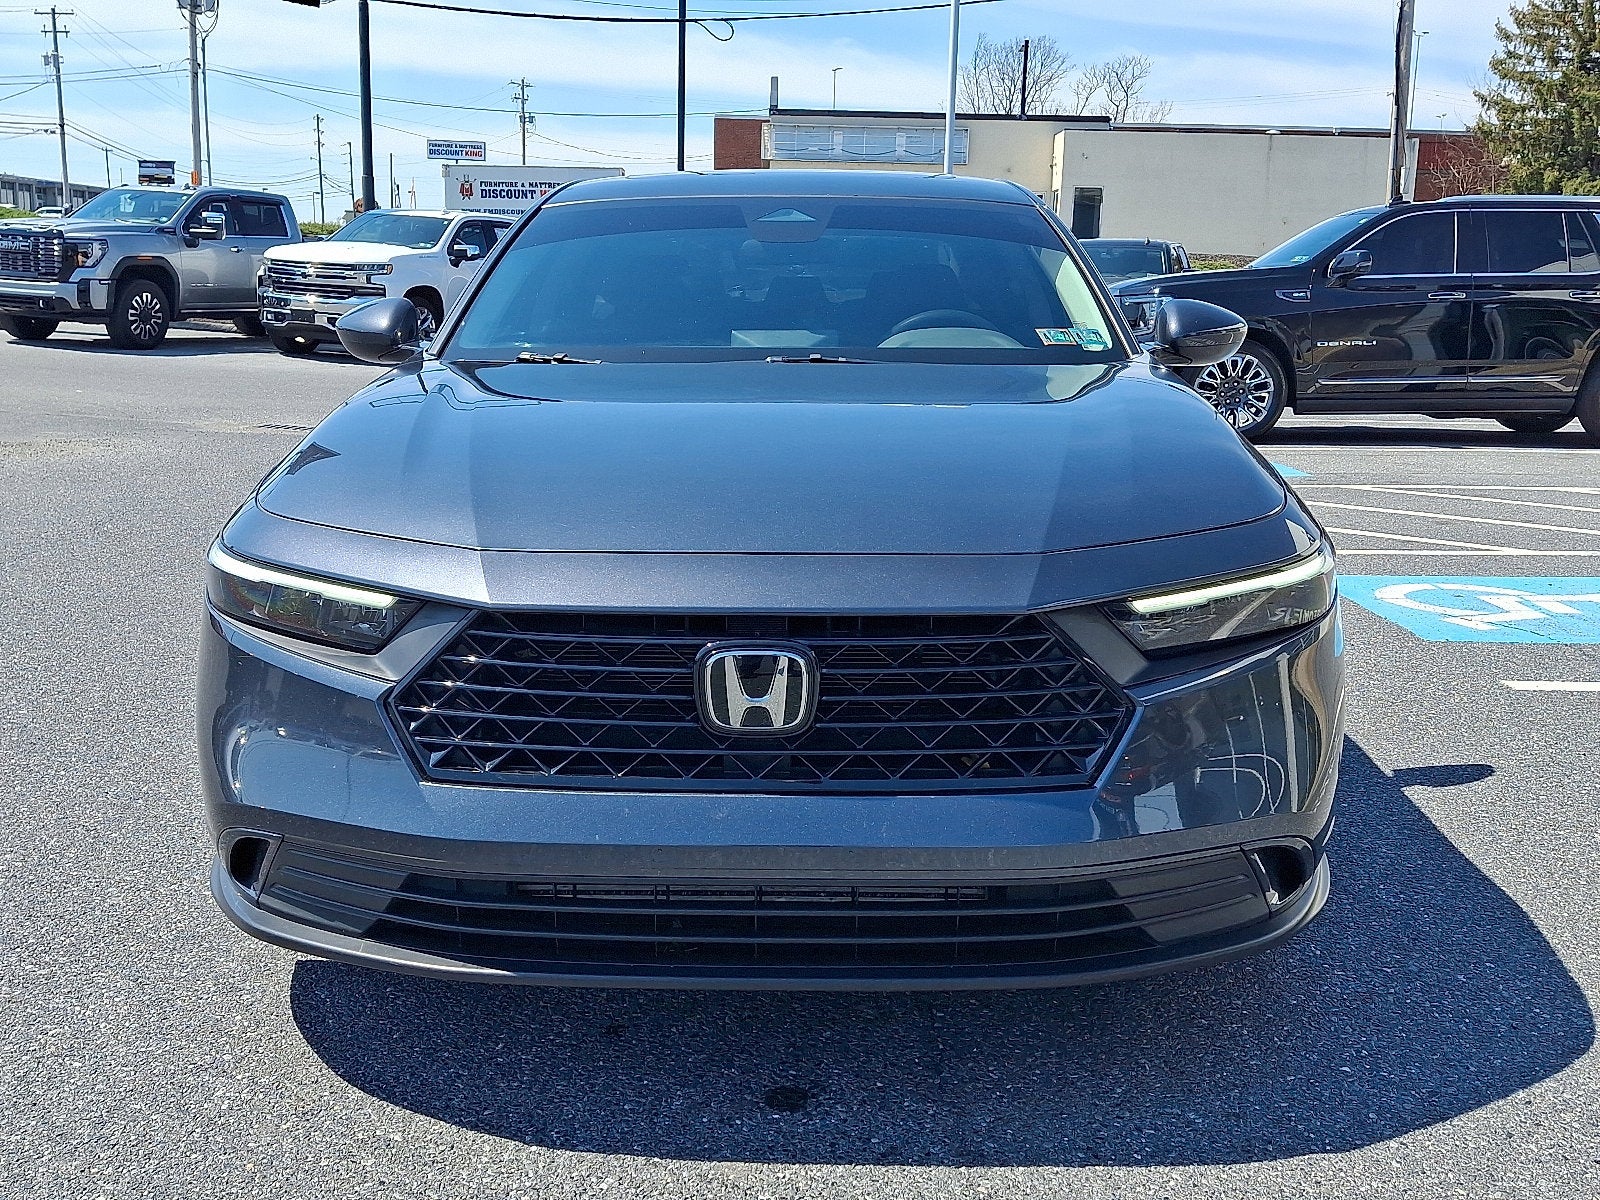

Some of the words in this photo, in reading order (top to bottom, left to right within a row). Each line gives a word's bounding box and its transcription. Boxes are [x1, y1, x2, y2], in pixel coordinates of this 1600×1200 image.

[428, 148, 464, 156] DISCOUNT
[464, 149, 483, 157] KING
[480, 188, 536, 199] DISCOUNT
